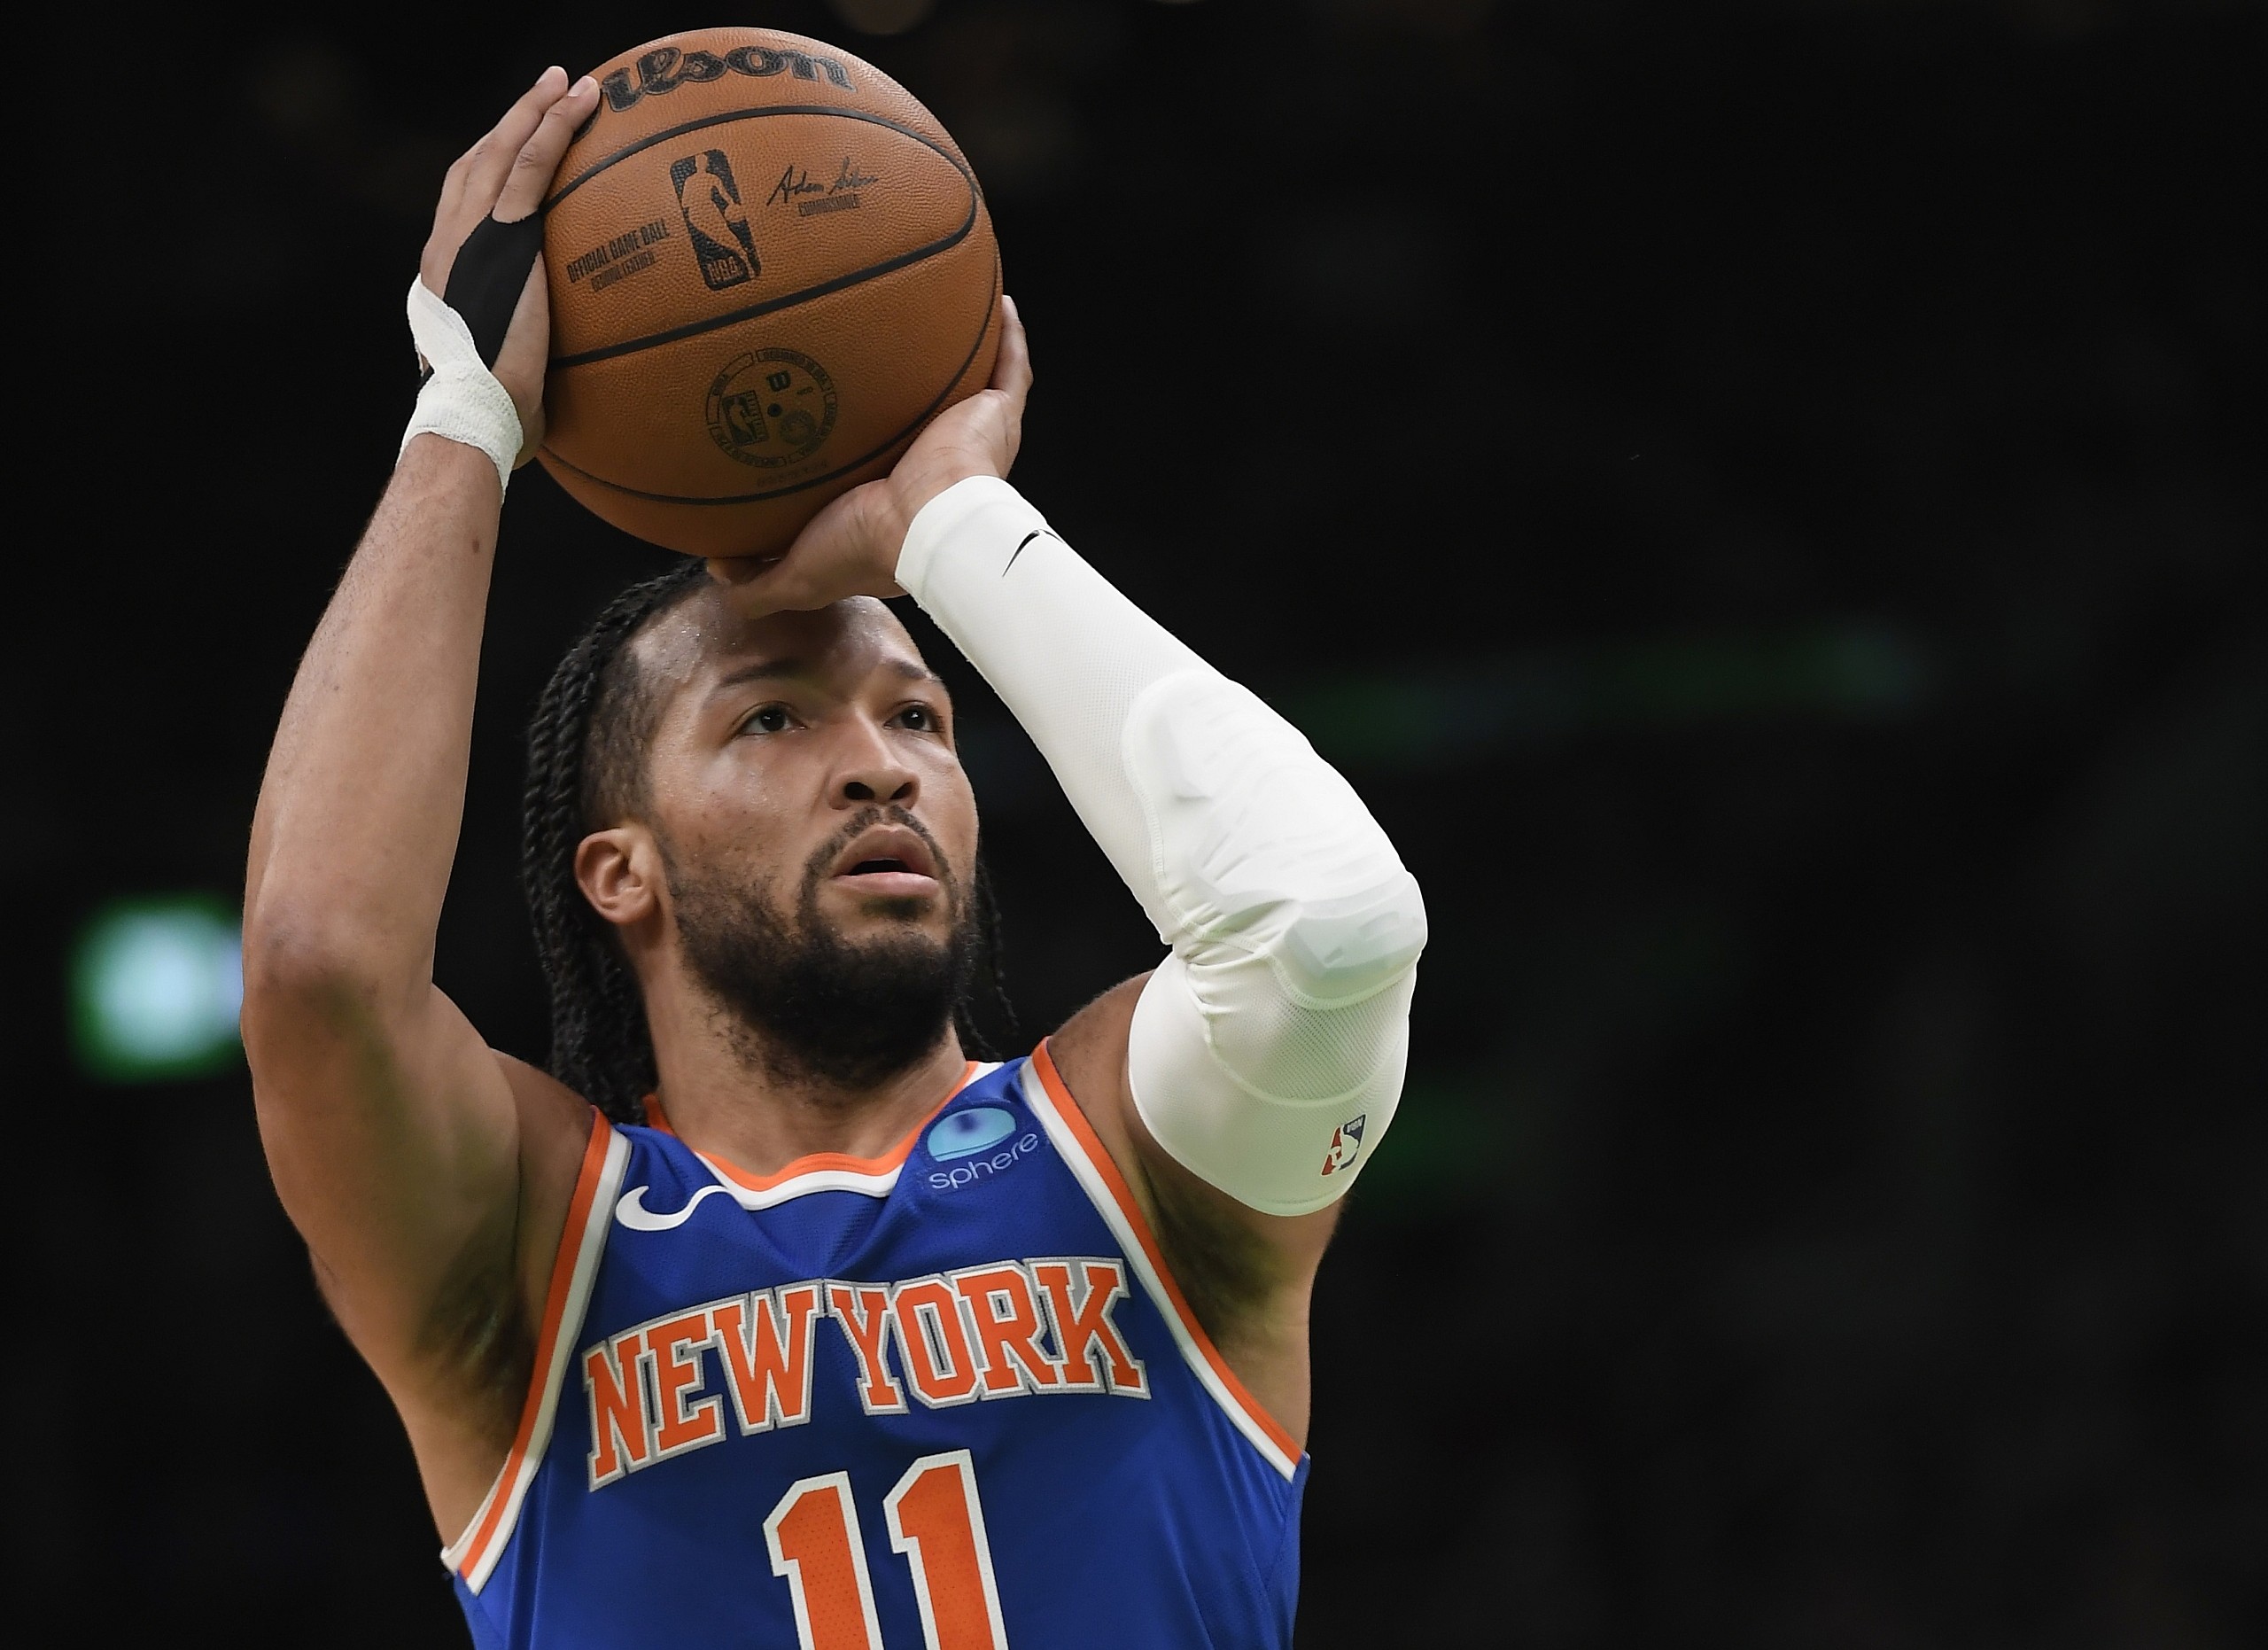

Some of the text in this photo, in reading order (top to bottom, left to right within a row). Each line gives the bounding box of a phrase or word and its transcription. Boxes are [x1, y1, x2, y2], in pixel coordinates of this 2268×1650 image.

[578, 46, 857, 133] ilson
[567, 218, 671, 284] OFFICIAL GAME BALL
[707, 255, 744, 285] NBA
[929, 1132, 1038, 1189] sphere
[582, 1257, 1151, 1492] NEW YORK
[762, 1448, 1008, 1650] 11
